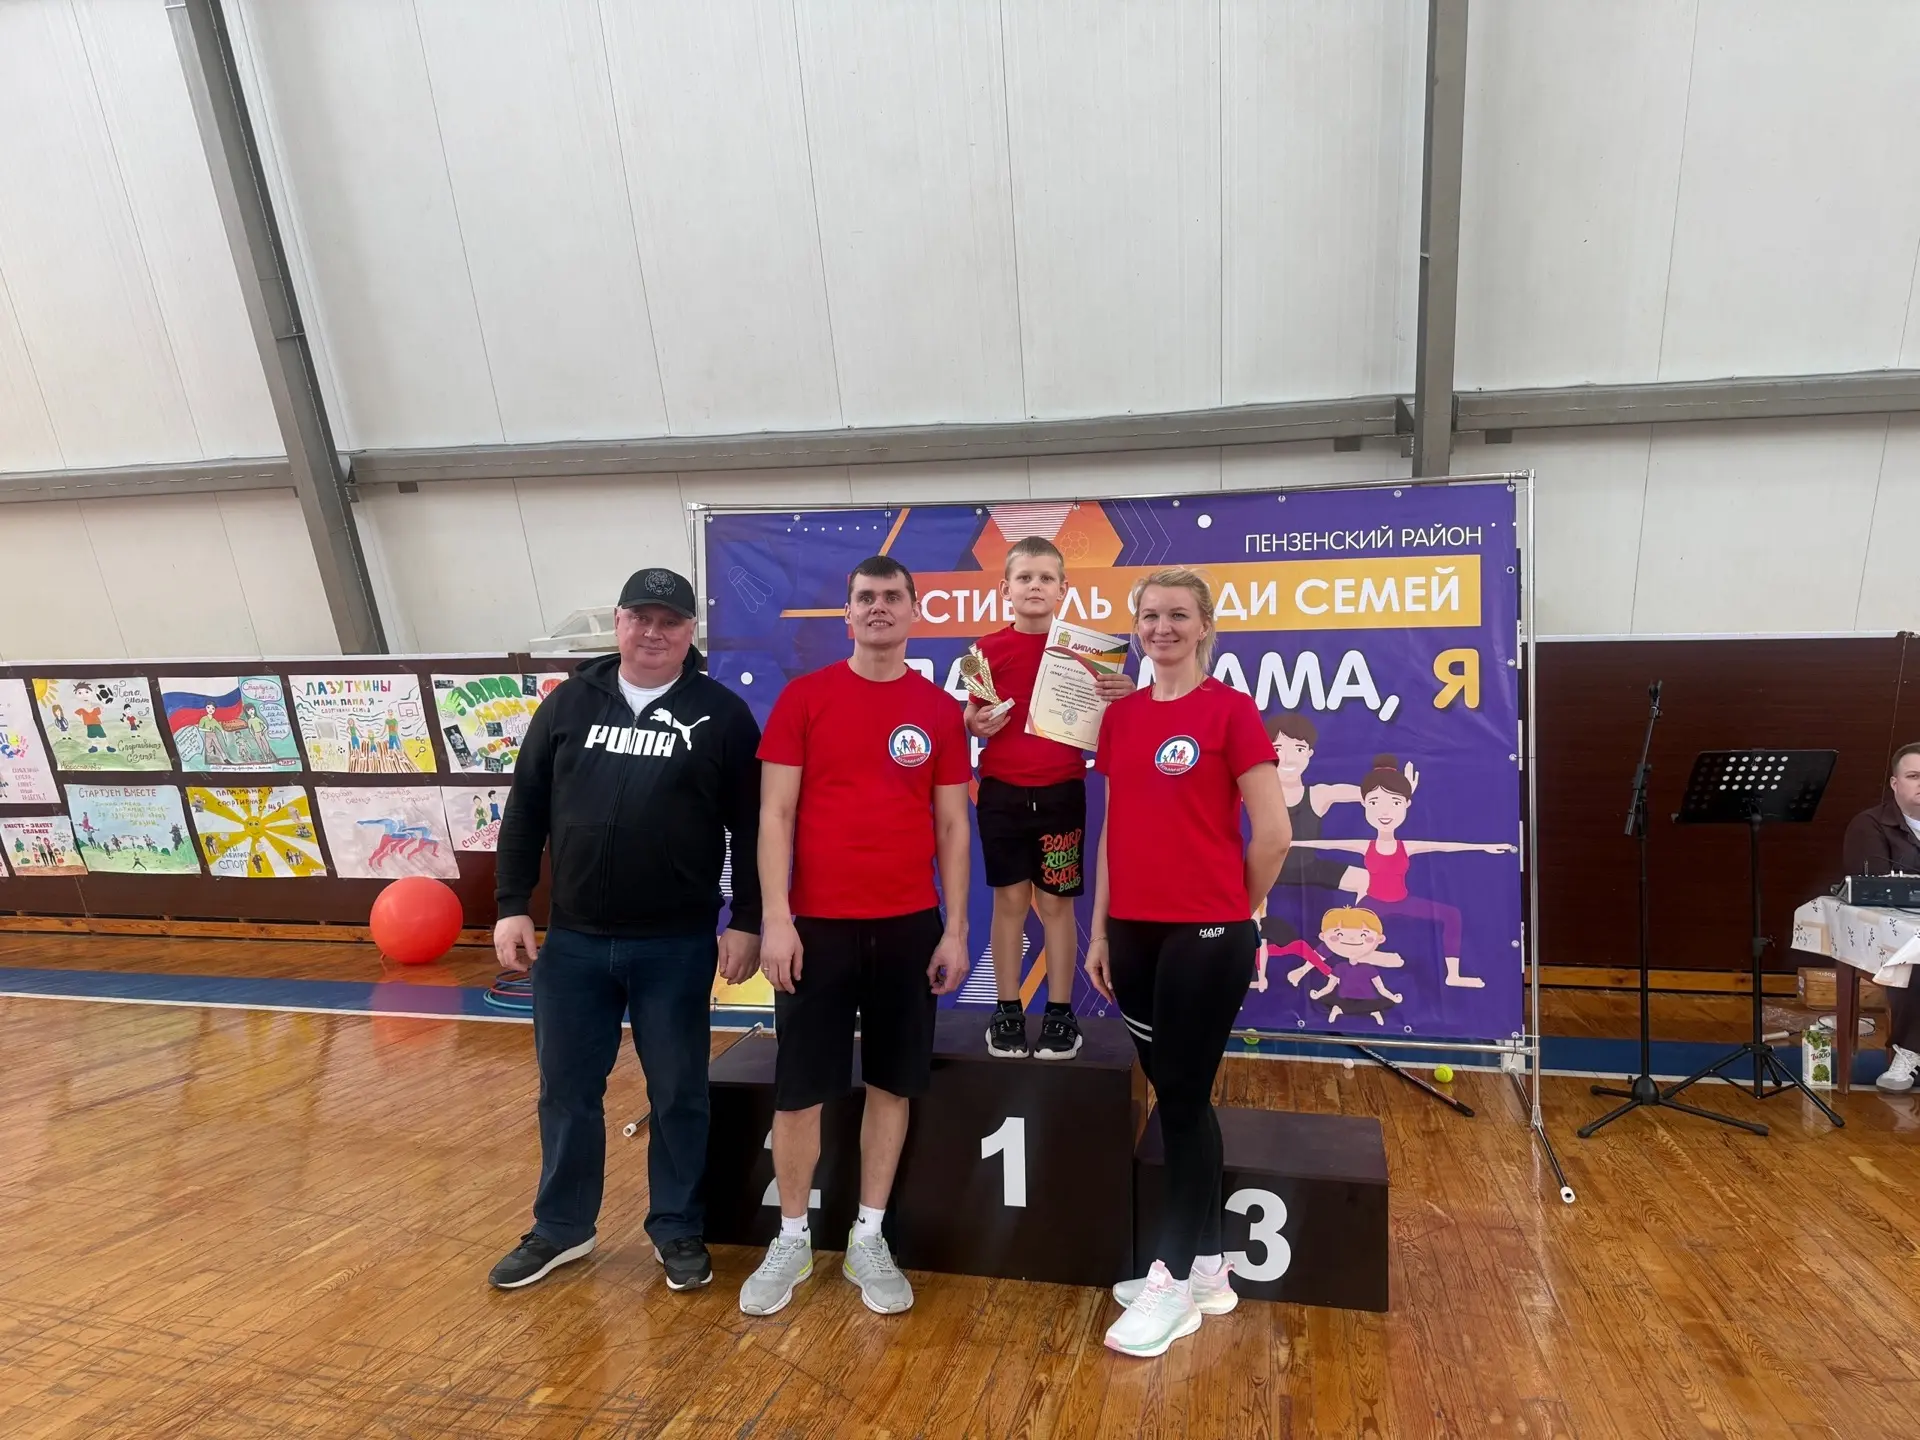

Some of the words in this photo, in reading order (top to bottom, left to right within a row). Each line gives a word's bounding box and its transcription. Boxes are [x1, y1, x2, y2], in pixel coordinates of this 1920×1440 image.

[1245, 525, 1393, 553] ПЕНЗЕНСКИЙ
[1401, 523, 1482, 548] РАЙОН
[1294, 566, 1460, 616] СЕМЕЙ
[1071, 642, 1104, 657] ДИПЛОМ
[305, 679, 392, 696] ЛАЗУТКИНЫ
[1433, 648, 1480, 710] Я
[584, 724, 678, 758] PUMA
[980, 1116, 1028, 1208] 1
[1224, 1187, 1292, 1283] 3
